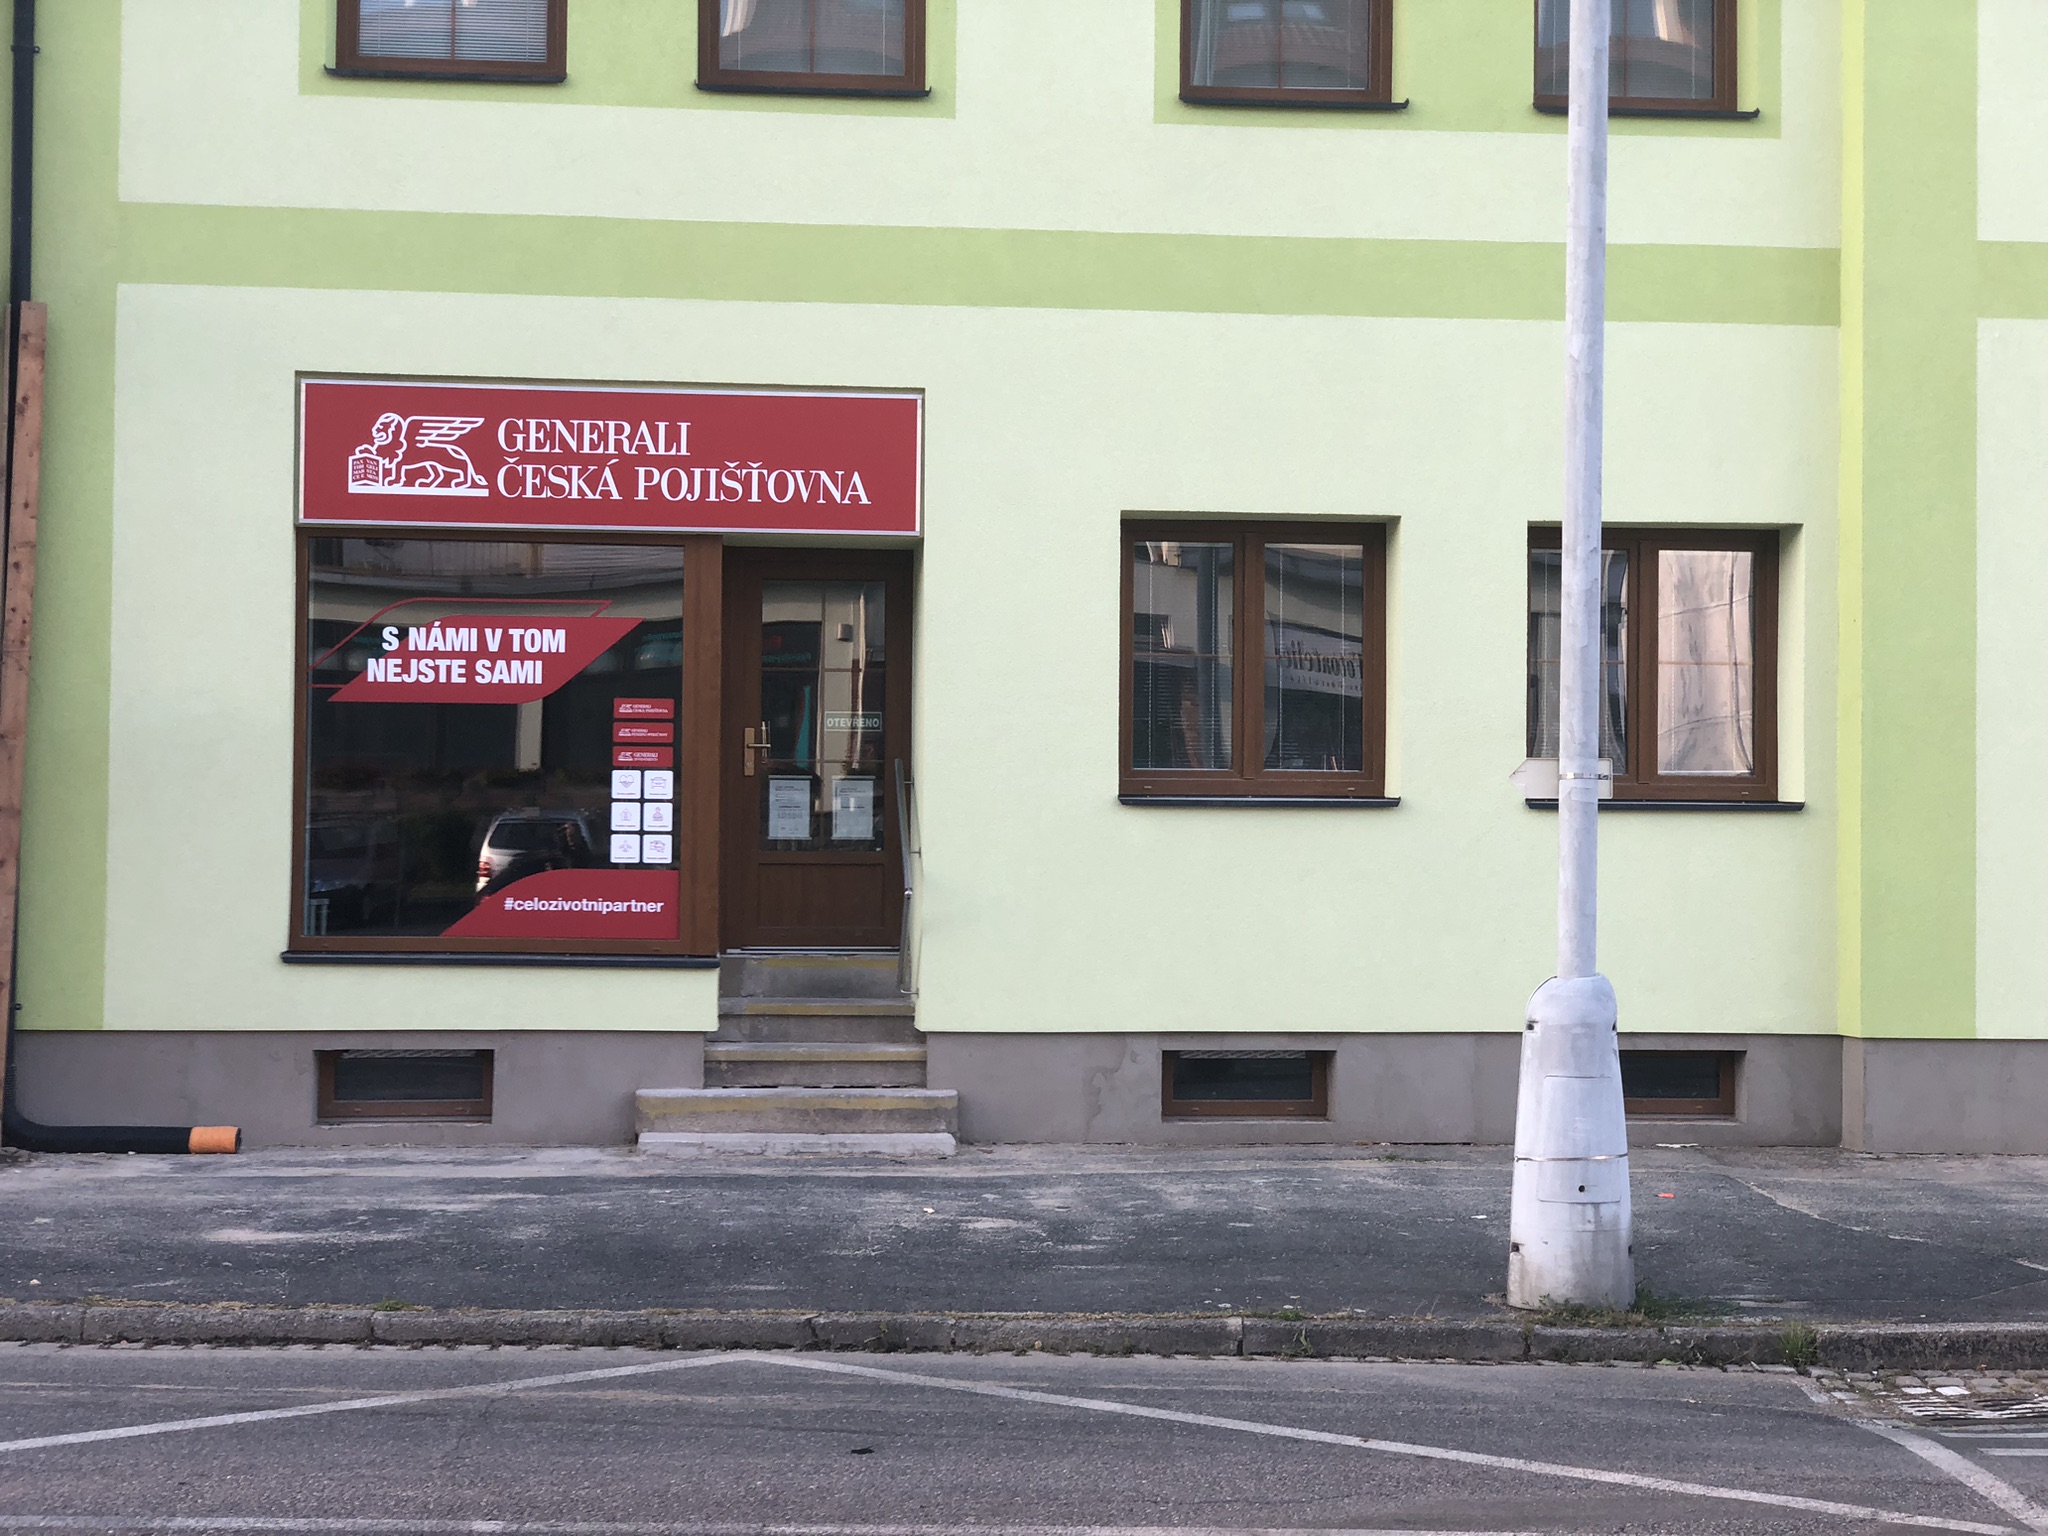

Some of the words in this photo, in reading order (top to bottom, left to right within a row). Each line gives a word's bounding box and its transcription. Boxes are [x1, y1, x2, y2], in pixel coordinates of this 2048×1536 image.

[497, 417, 691, 456] GENERALI
[497, 456, 623, 500] ČESKÁ
[633, 460, 872, 505] POJIŠŤOVNA
[381, 626, 400, 651] S
[408, 621, 478, 652] NÁMI
[484, 627, 503, 652] V
[508, 628, 566, 653] TOM
[367, 658, 467, 684] NEJSTE
[474, 659, 543, 685] SAMI
[826, 716, 880, 727] OTEVŘENO
[503, 897, 665, 915] #celozivotnipartner
